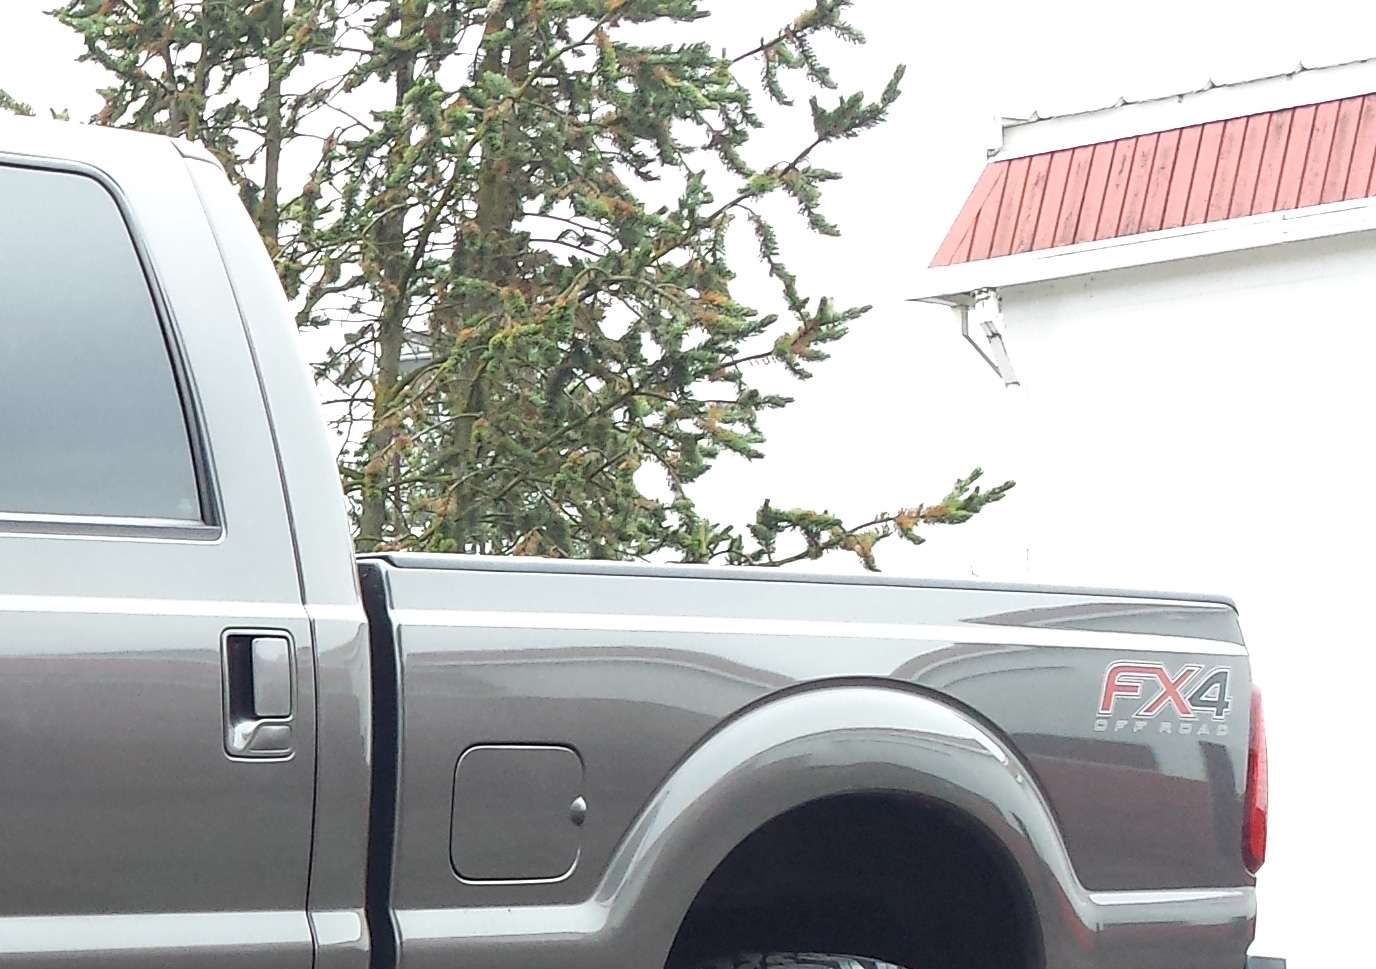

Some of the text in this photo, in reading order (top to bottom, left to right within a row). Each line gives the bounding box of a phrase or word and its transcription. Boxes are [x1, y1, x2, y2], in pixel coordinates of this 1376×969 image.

[1098, 661, 1232, 721] FX4
[1094, 719, 1229, 736] OFF ROAD
